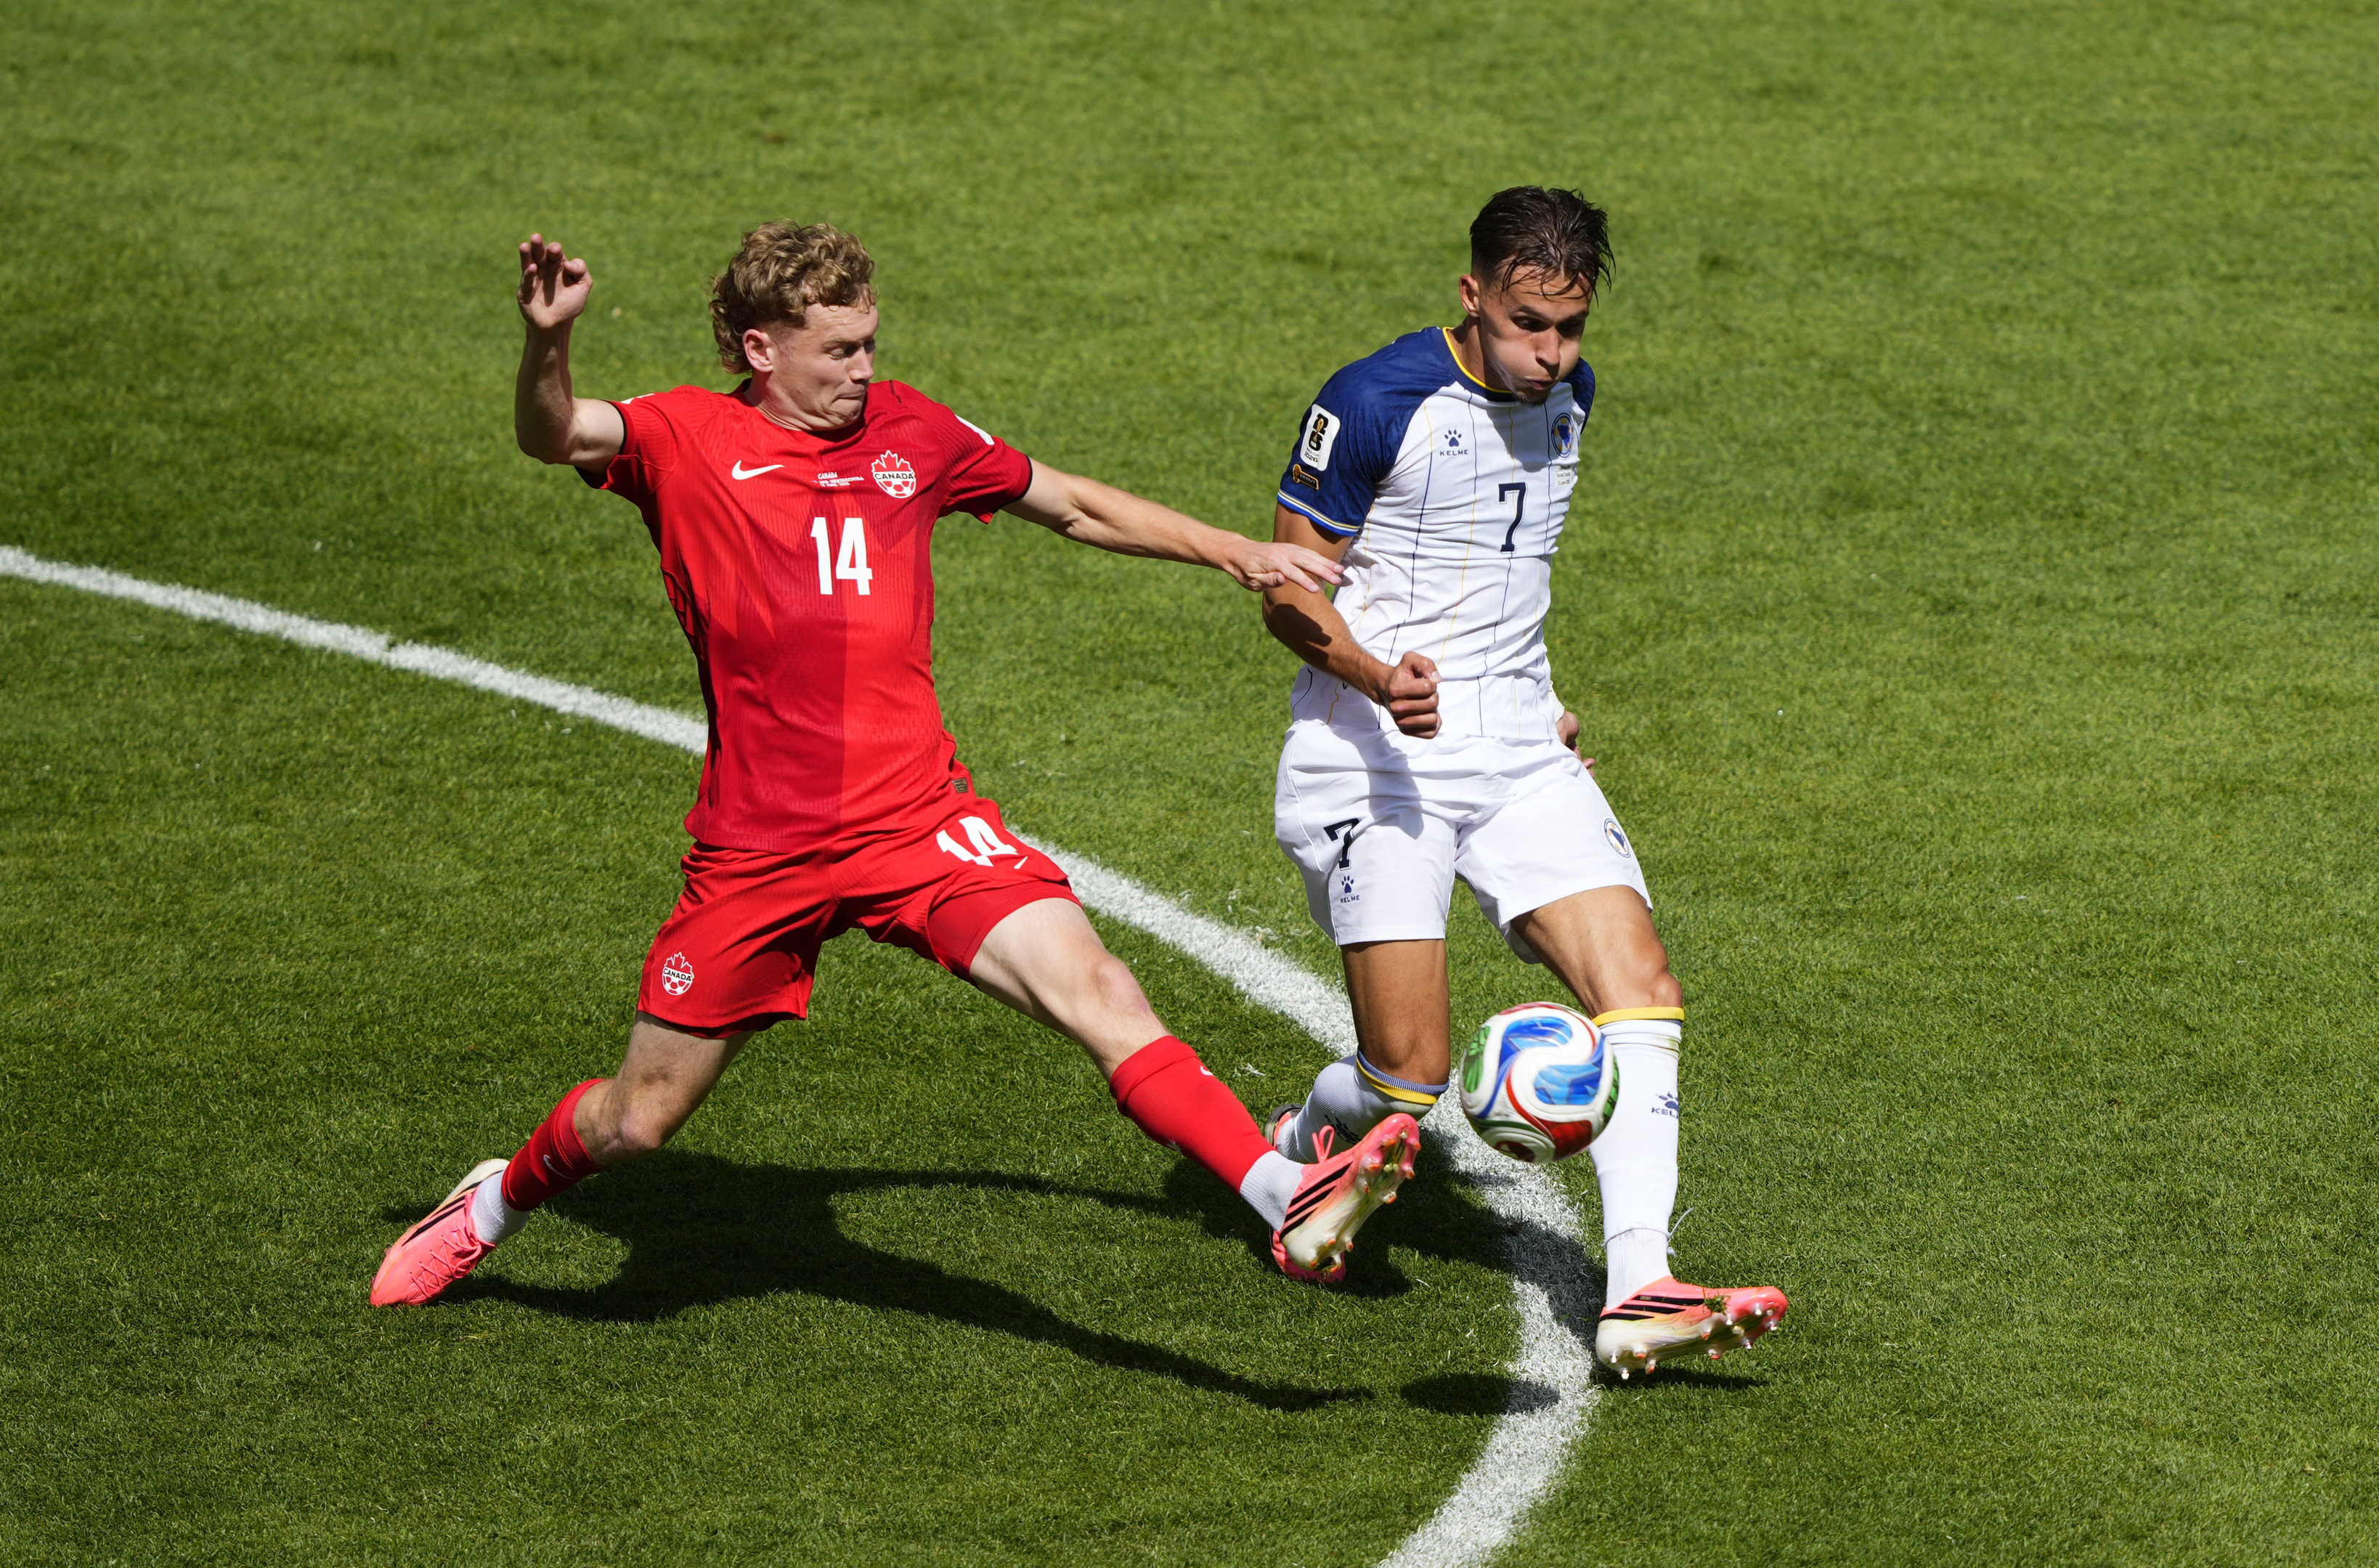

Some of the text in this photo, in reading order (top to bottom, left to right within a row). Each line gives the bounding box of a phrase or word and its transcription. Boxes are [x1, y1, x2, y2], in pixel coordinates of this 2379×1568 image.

[1498, 482, 1528, 554] 7
[810, 517, 873, 596] 14
[936, 816, 1019, 867] 14
[1323, 817, 1361, 871] 7
[1341, 895, 1360, 903] KELME
[663, 968, 691, 981] CANADA
